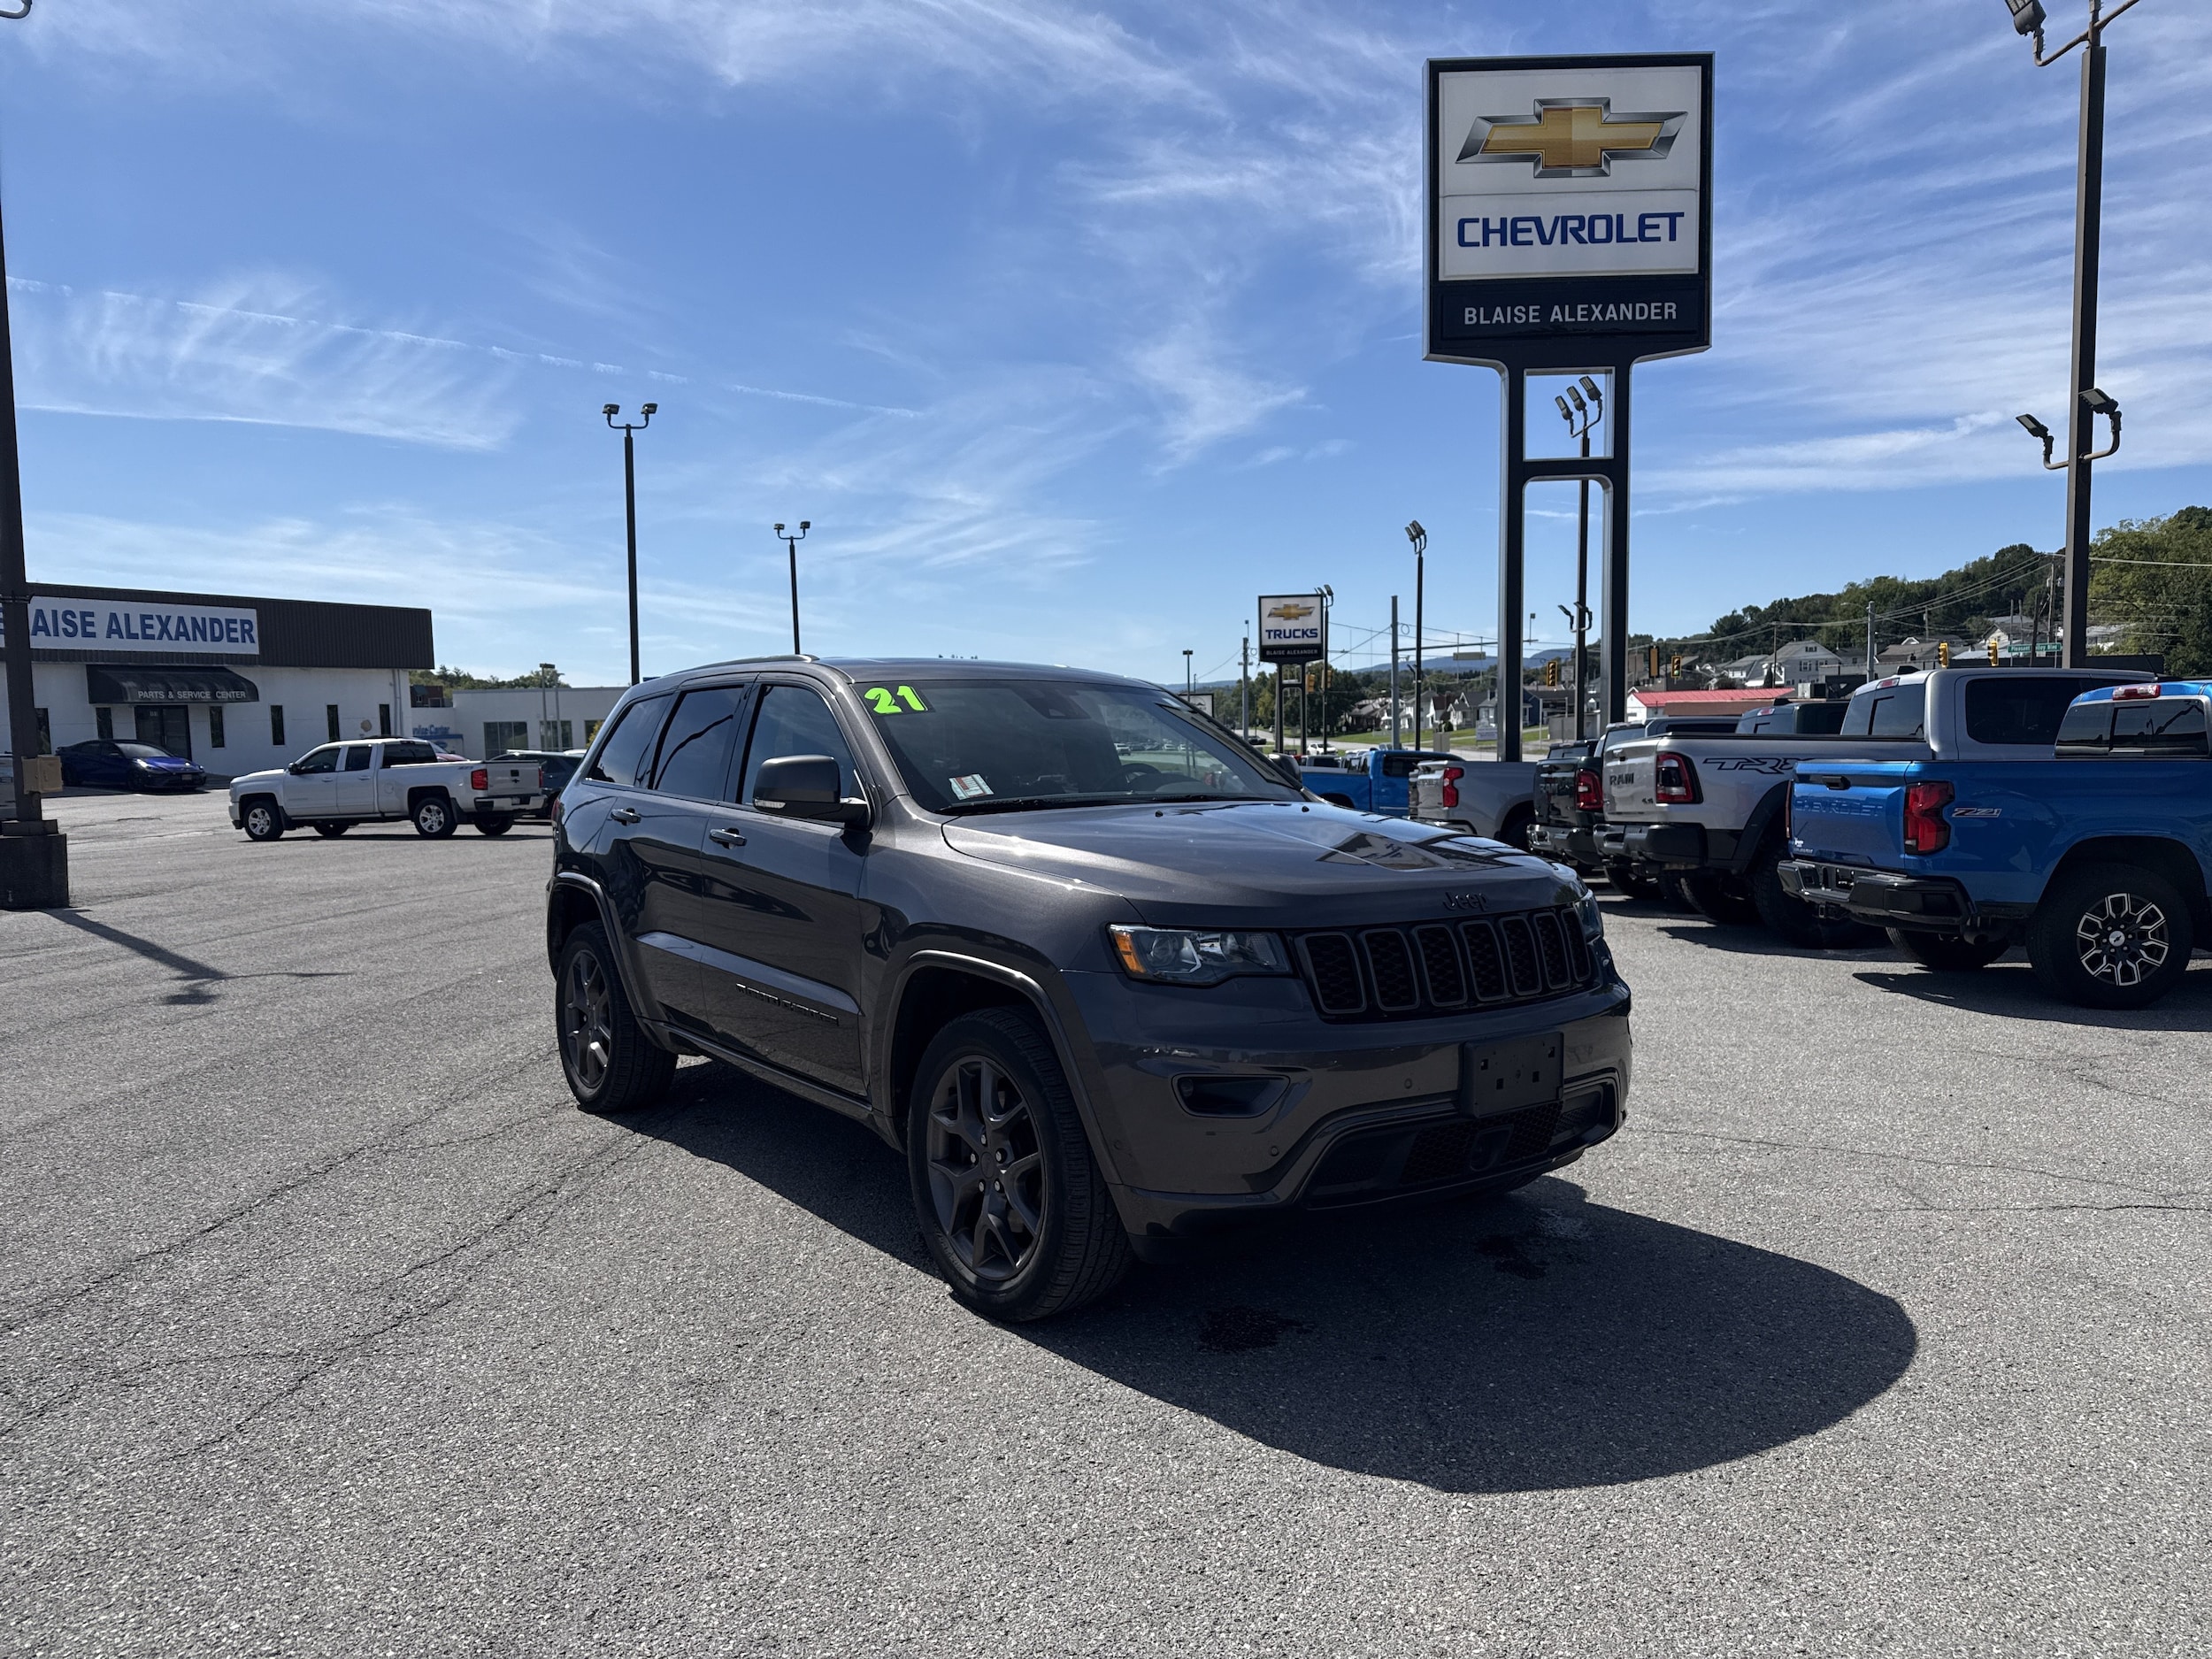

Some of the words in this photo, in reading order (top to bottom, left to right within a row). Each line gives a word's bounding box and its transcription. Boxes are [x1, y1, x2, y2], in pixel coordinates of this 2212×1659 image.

[1457, 211, 1685, 248] CHEVROLET
[1464, 305, 1540, 325] BLAISE
[1550, 302, 1677, 323] ALEXANDER
[0, 607, 96, 638] AISE
[105, 612, 256, 644] ALEXANDER
[1265, 628, 1318, 640] TRUCKS
[864, 685, 928, 714] 21
[1609, 772, 1634, 786] RAM
[1442, 891, 1488, 912] Jeep
